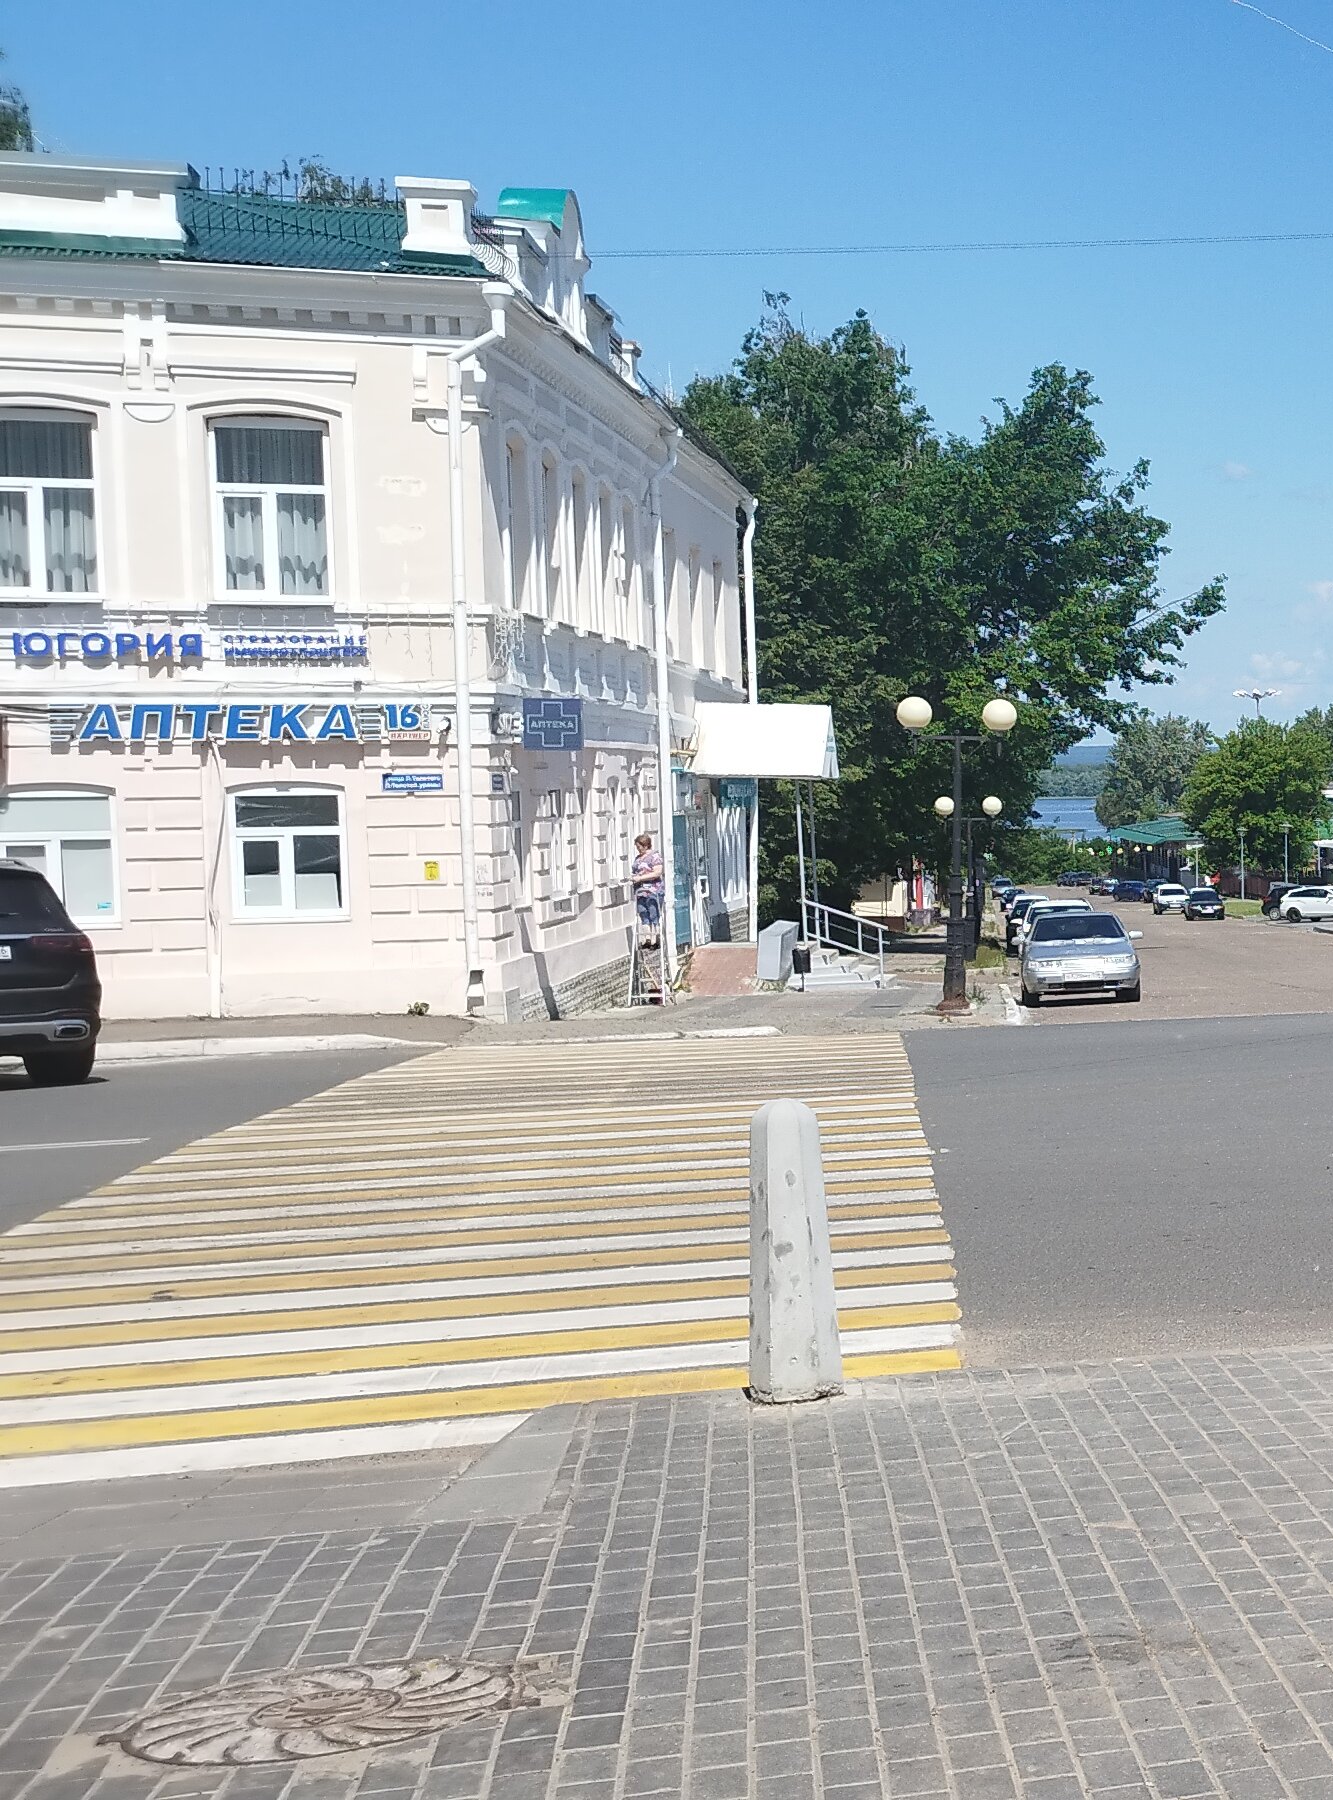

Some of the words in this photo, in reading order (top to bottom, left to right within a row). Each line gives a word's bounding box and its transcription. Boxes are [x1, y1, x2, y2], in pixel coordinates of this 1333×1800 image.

[13, 632, 203, 657] ЮГОРИЯ
[79, 703, 359, 741] АПТЕКА
[384, 703, 421, 731] 16
[530, 719, 575, 729] АПТЕКА
